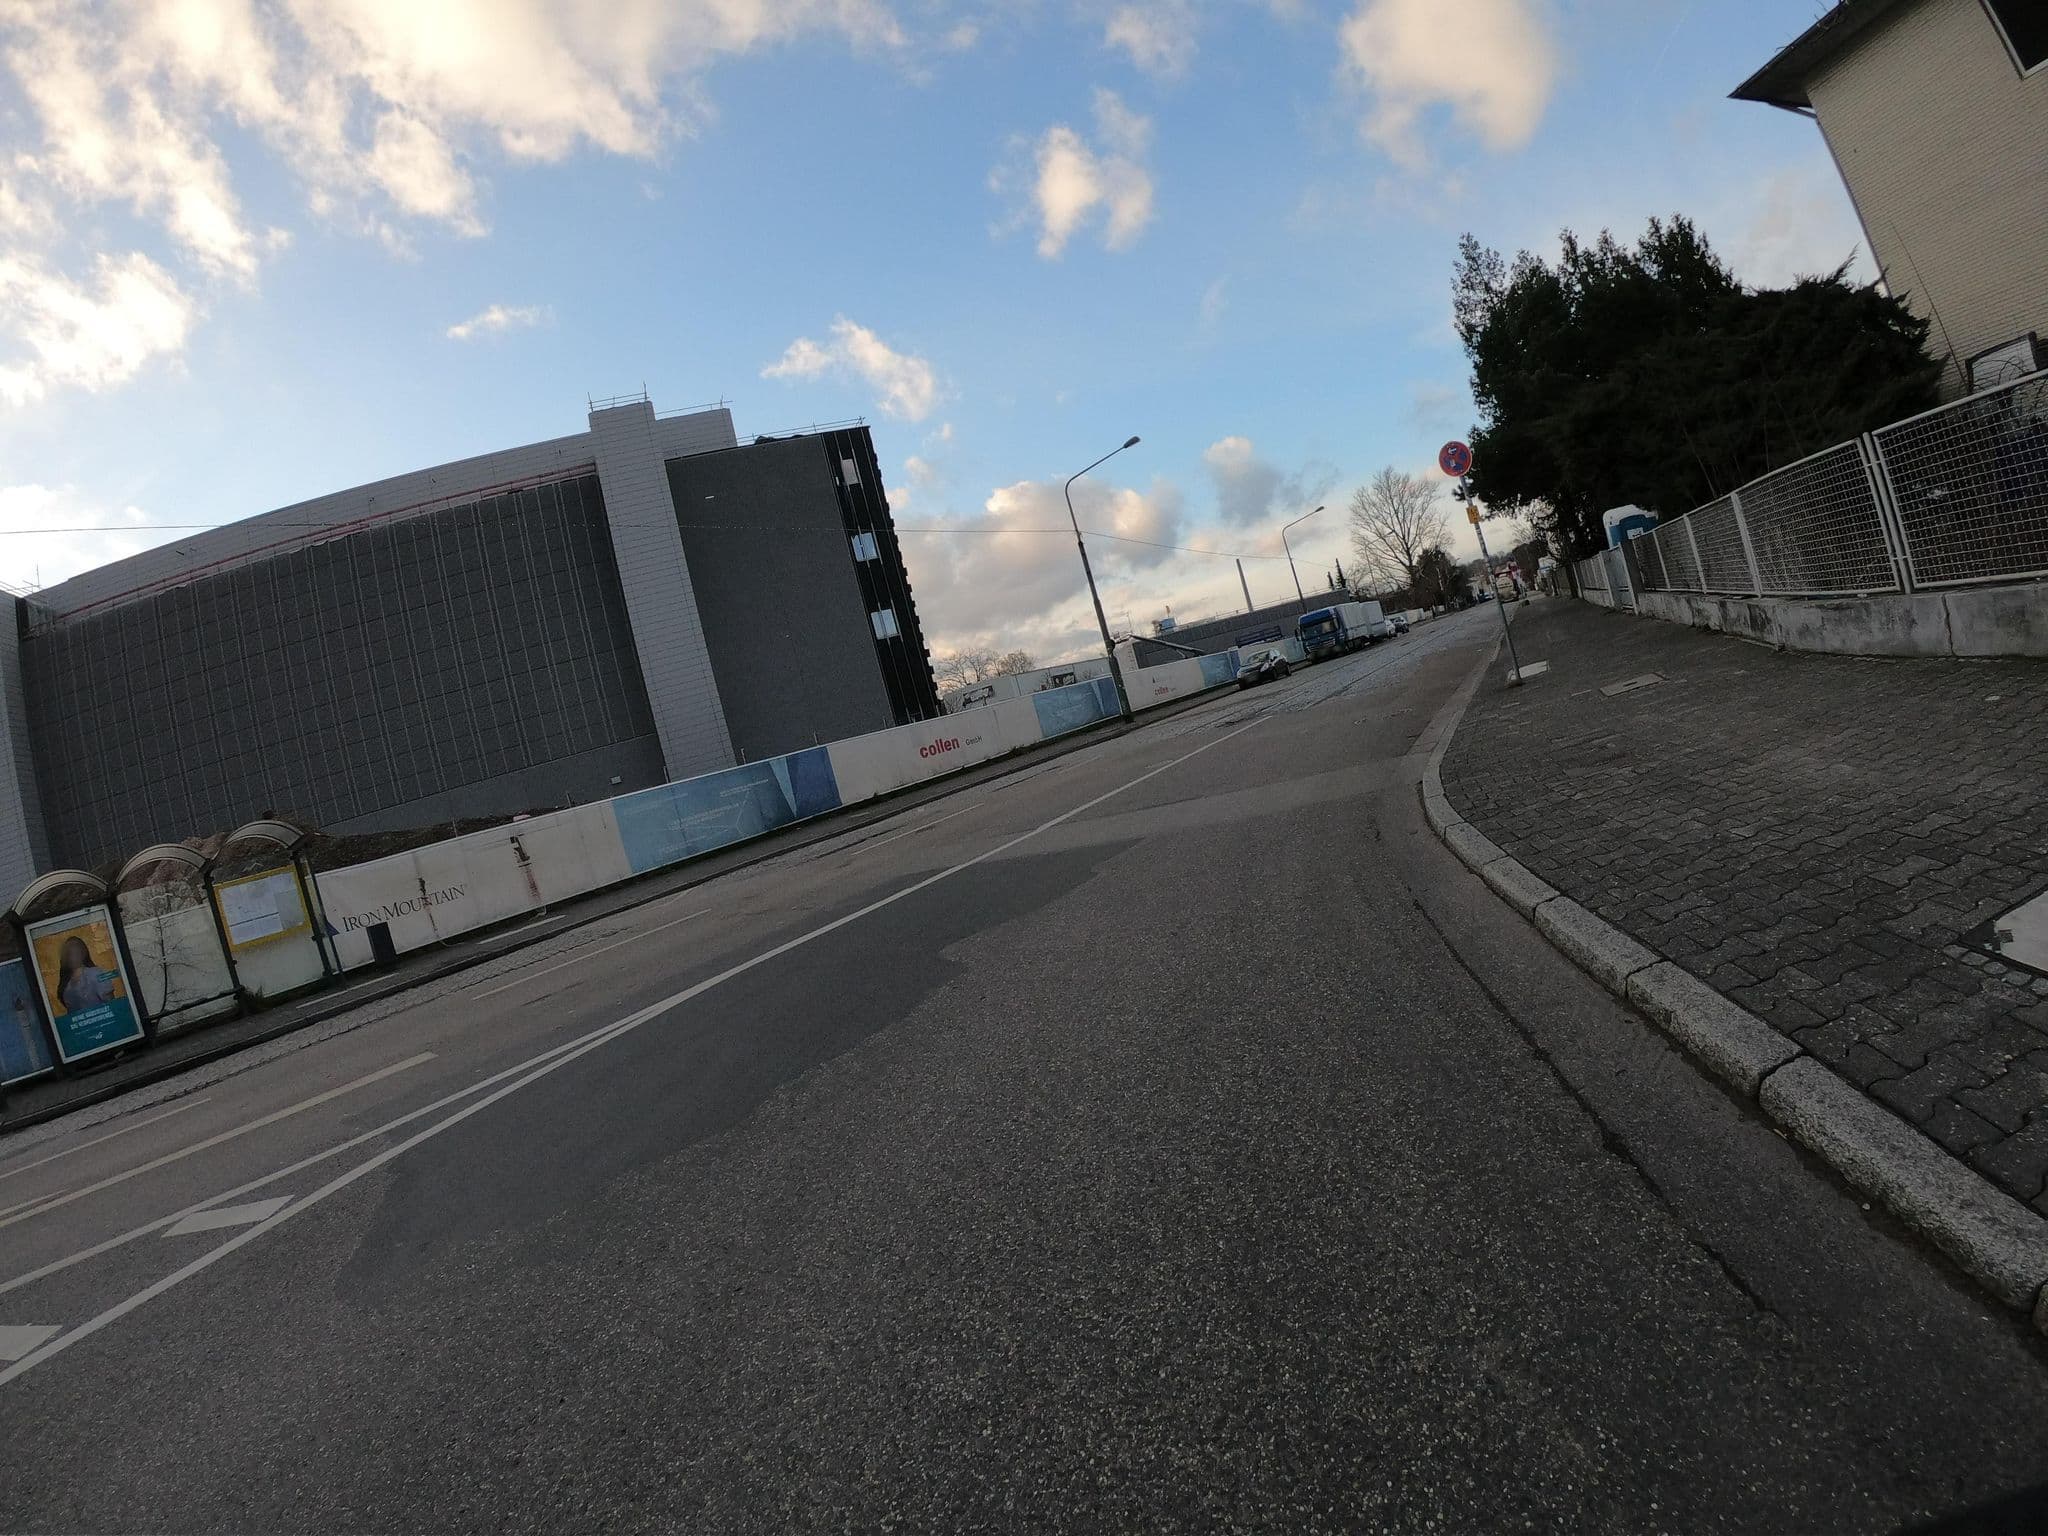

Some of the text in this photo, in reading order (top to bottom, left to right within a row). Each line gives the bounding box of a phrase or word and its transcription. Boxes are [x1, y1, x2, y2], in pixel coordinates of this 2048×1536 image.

[919, 735, 983, 759] collen GmbH
[342, 908, 383, 932] IRON
